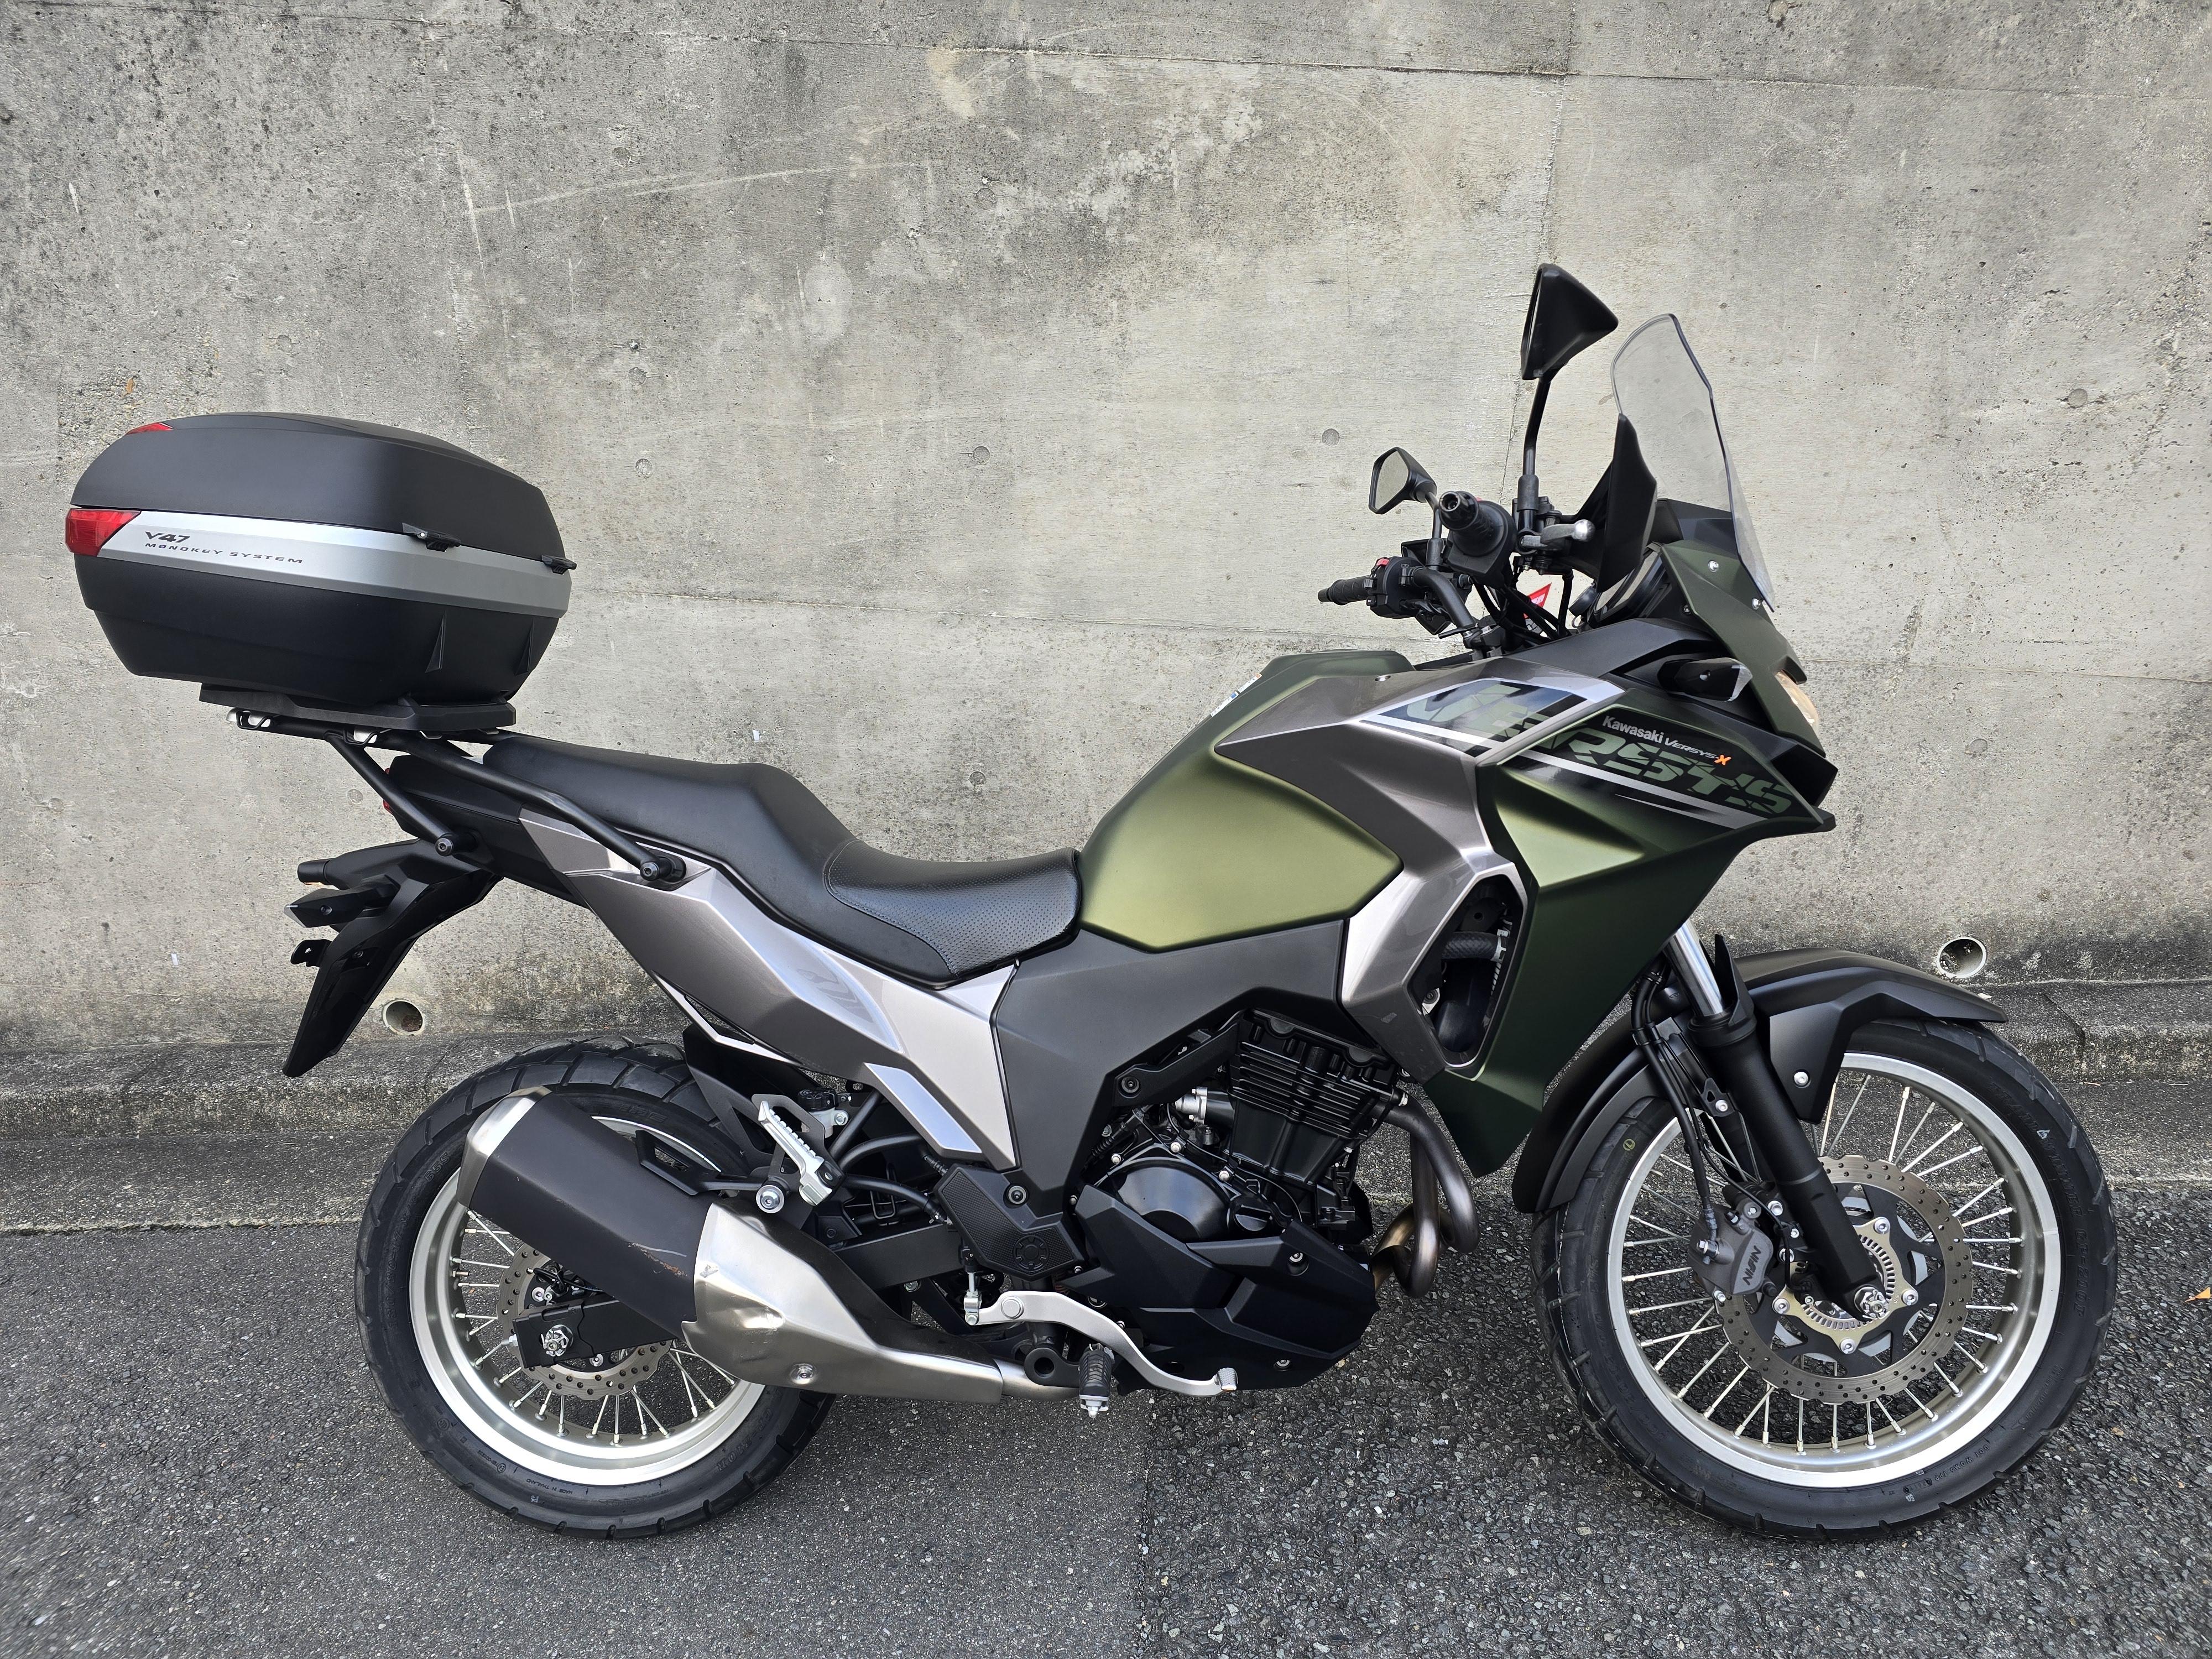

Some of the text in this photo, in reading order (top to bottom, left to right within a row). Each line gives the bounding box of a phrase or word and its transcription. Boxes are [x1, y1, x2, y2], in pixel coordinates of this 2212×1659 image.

[145, 531, 191, 543] V47
[145, 542, 303, 564] MONOKEY SYSTEM
[1602, 715, 1665, 744] Kawasaki
[425, 1152, 451, 1182] 65S
[1975, 1444, 1990, 1458] DOT
